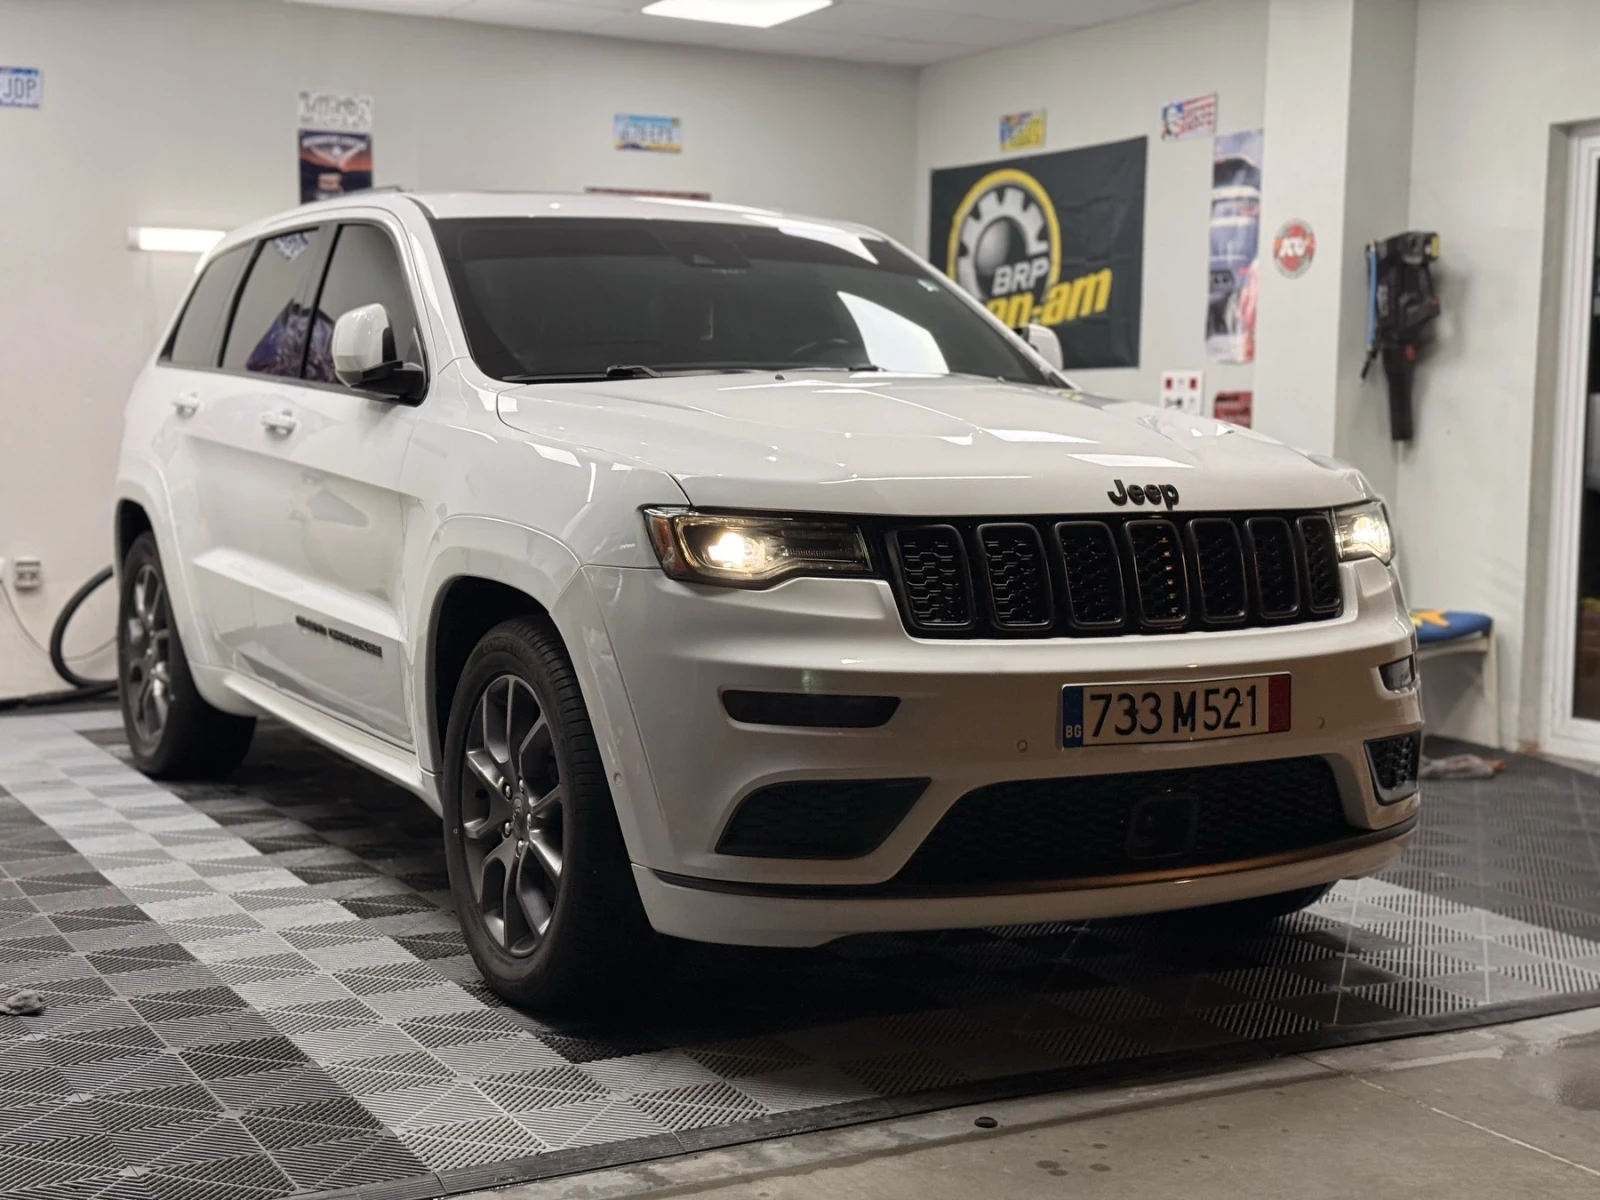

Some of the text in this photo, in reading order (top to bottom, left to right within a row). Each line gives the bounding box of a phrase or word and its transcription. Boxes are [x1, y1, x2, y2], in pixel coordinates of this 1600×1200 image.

[3, 77, 38, 99] JDP
[991, 256, 1049, 296] BRP
[984, 267, 1113, 329] an-am
[1107, 479, 1179, 511] Jeep
[1065, 725, 1082, 739] BG
[1090, 691, 1163, 737] 733
